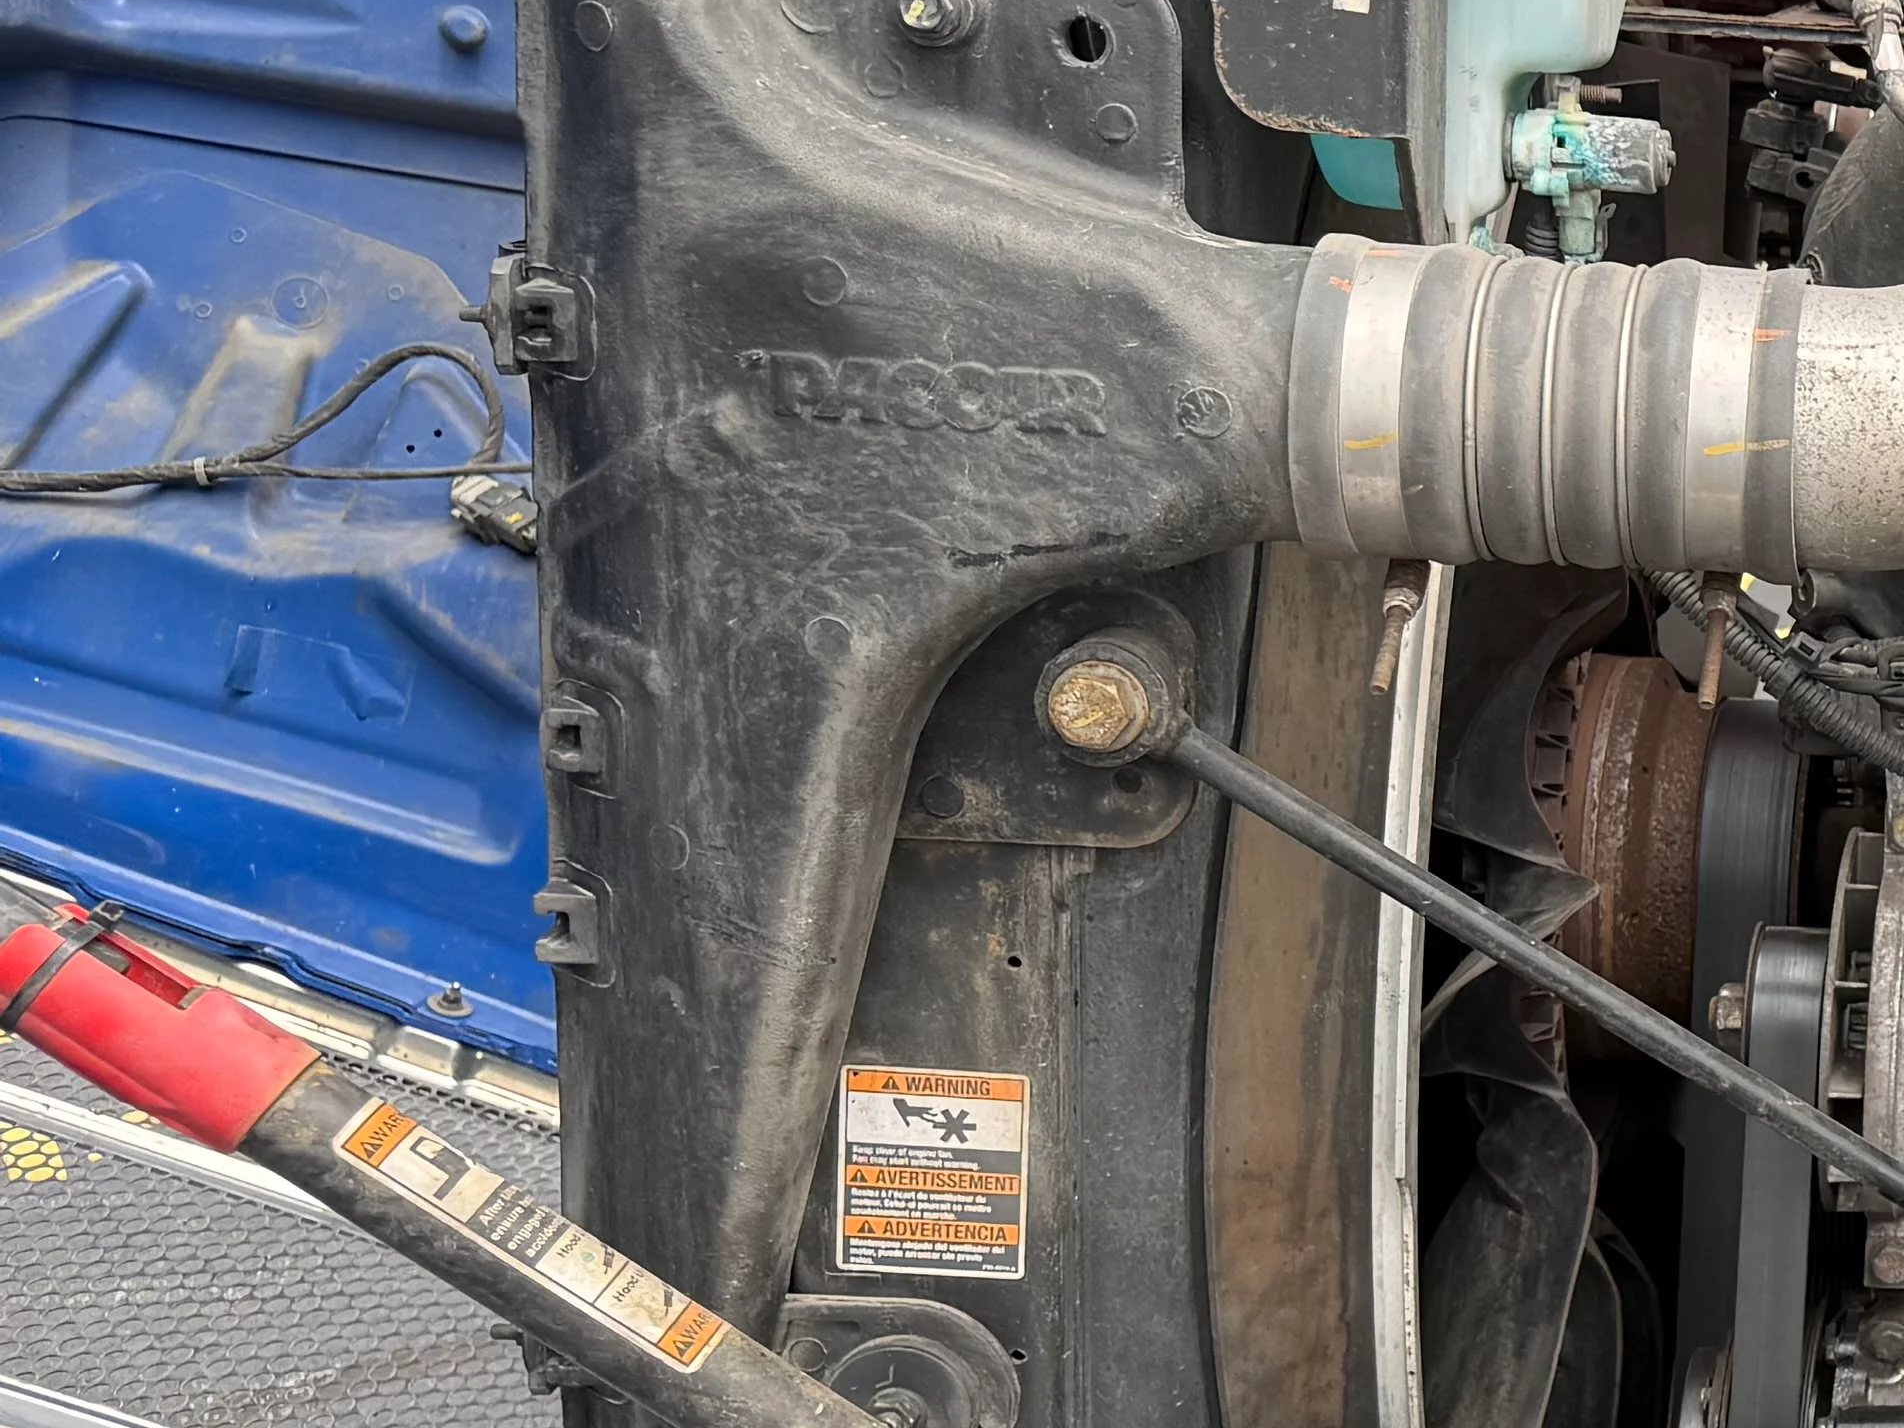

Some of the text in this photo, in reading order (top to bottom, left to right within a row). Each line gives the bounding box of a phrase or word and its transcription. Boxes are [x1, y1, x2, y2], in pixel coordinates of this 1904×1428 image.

[905, 1076, 991, 1096] WARNING
[876, 1169, 1016, 1192] AVERTISSEMENT
[883, 1221, 1007, 1242] ADVERTENCIA
